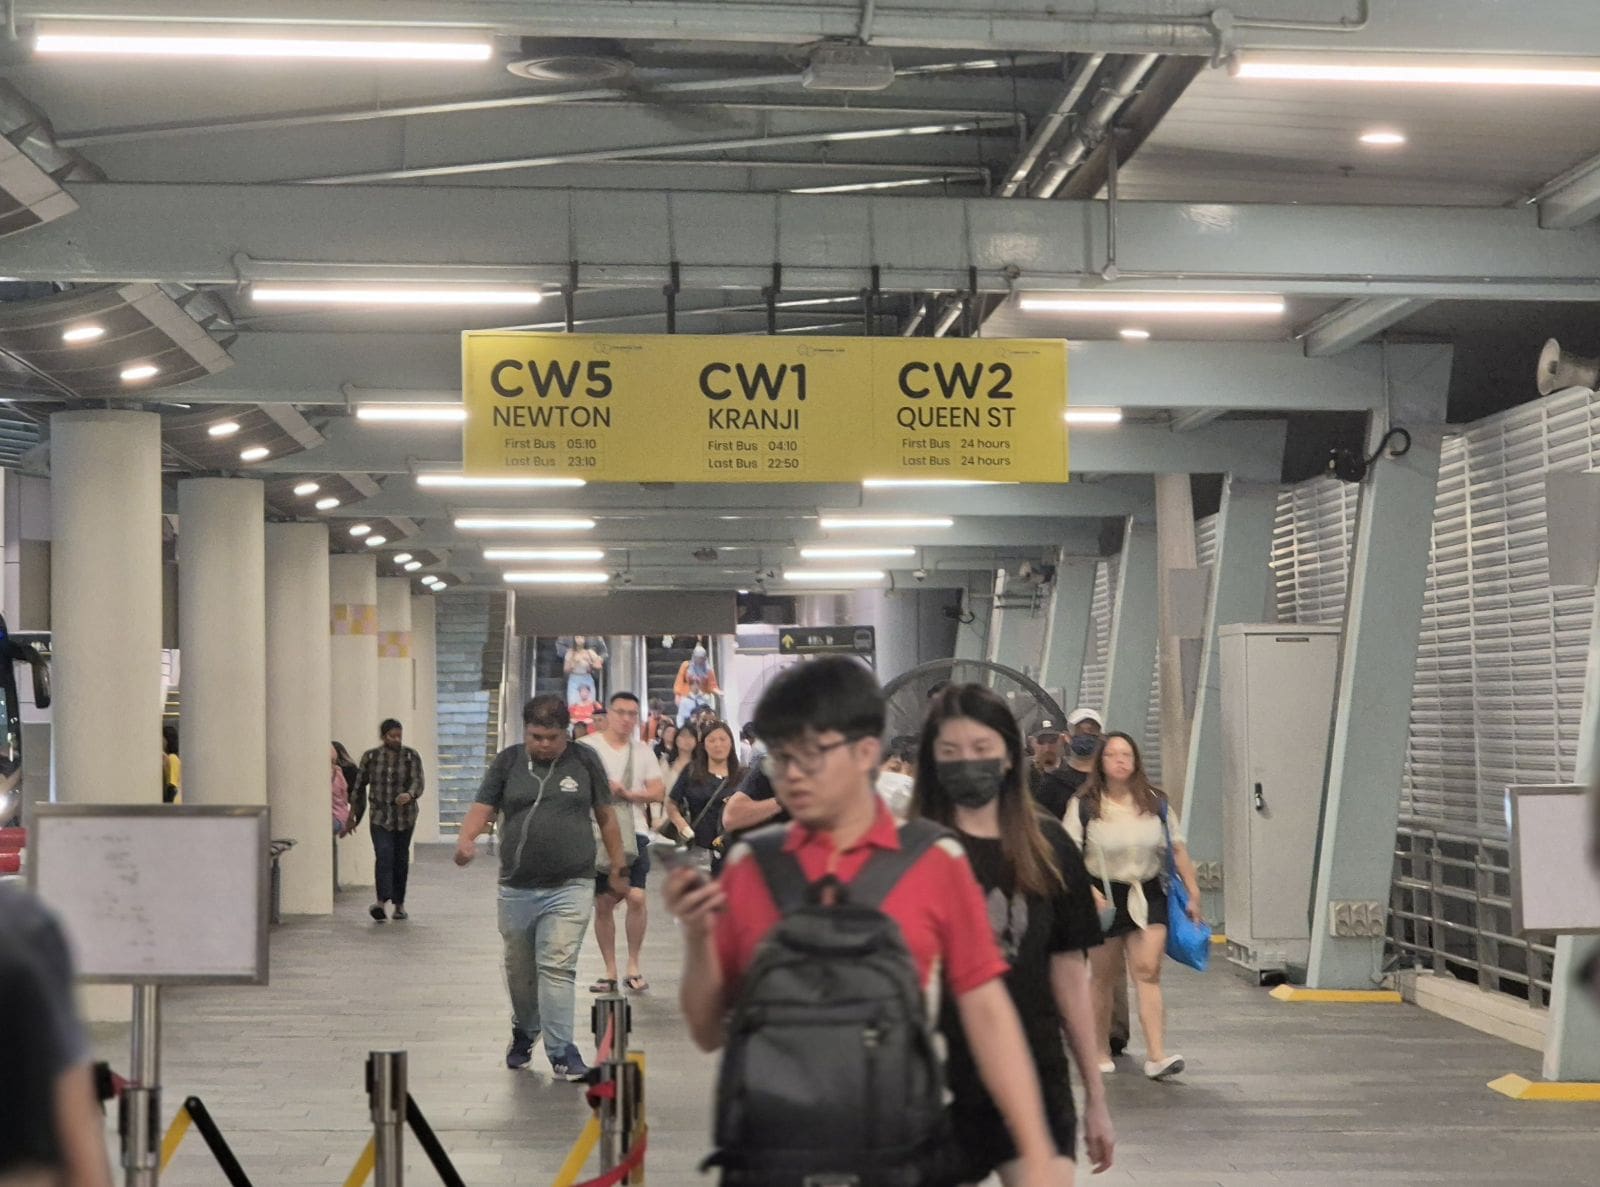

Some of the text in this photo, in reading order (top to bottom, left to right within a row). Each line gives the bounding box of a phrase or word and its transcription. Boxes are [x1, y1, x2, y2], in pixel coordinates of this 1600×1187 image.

[490, 359, 613, 399] CW5
[699, 362, 806, 401] CW1
[898, 361, 1013, 400] CW2
[493, 405, 611, 428] NEWTON
[709, 408, 799, 430] KRANJI
[896, 406, 1016, 430] QUEEN ST
[505, 438, 597, 450] First Bus 05:10
[708, 440, 798, 452] First Bus 04:10
[902, 438, 1011, 450] First Bus 24 hours
[505, 456, 597, 467] Last Bus 23:10
[708, 459, 799, 469] Last Bus 22:50
[902, 455, 1011, 466] Last Bus 24 hours
